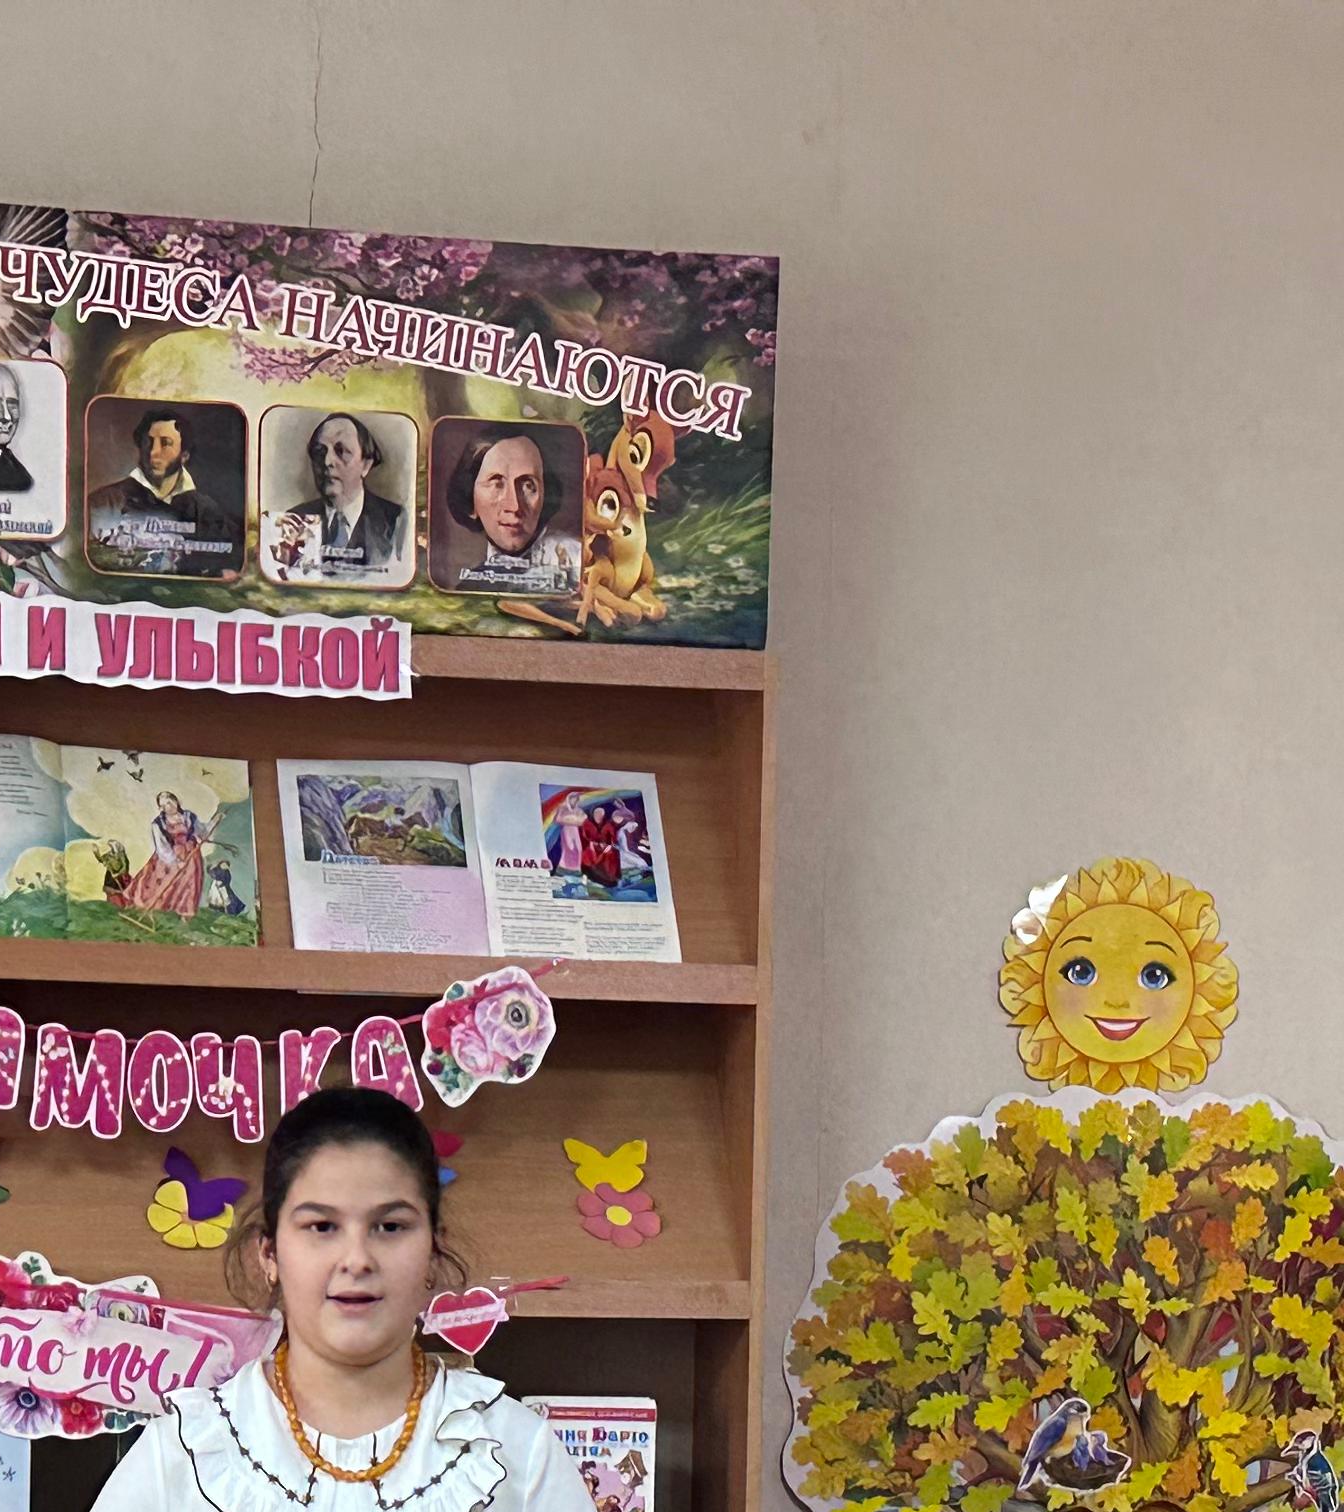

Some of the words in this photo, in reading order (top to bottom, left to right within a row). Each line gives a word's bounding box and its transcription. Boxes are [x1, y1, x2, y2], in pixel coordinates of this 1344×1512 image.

[278, 284, 751, 441] НАЧИНАЮТСЯ
[28, 606, 66, 671] И
[96, 611, 402, 693] УЛЫБКОЙ
[81, 1335, 216, 1392] ты!
